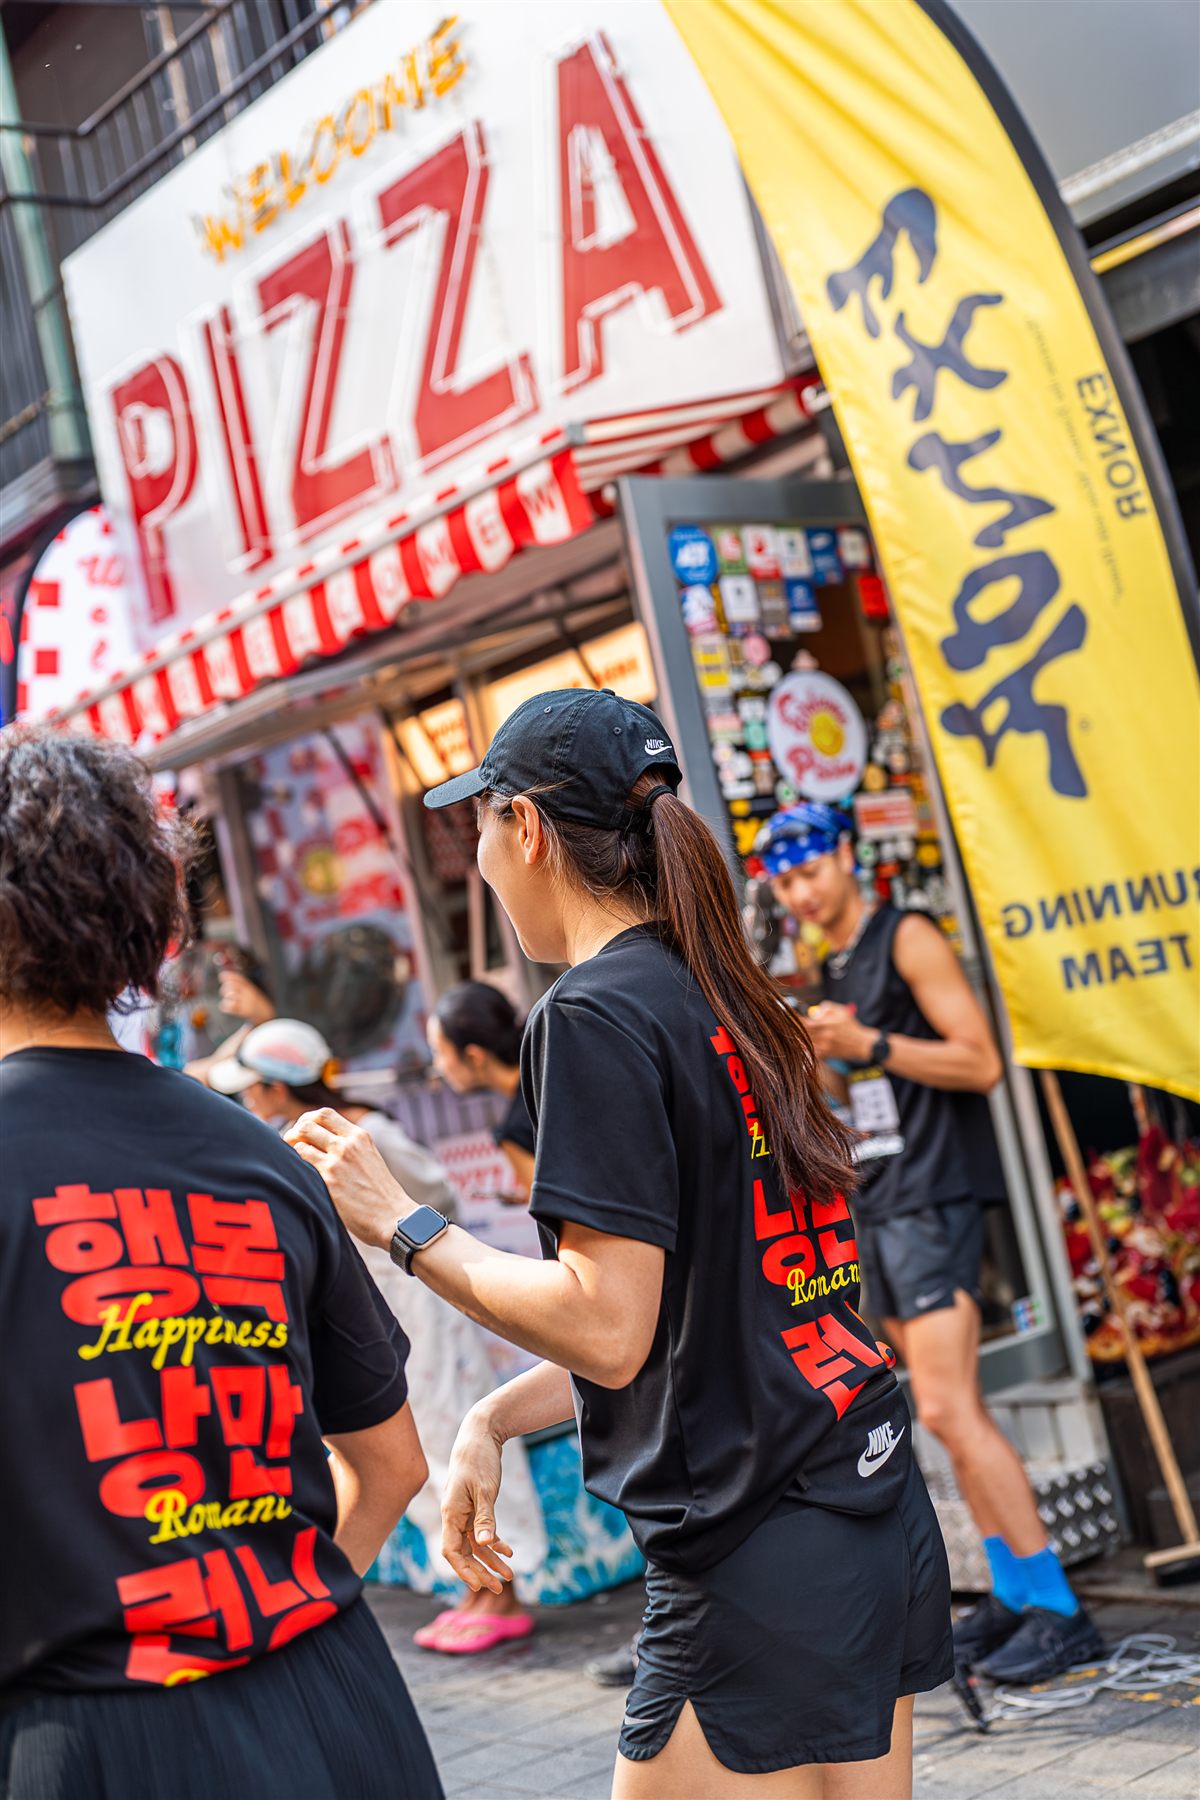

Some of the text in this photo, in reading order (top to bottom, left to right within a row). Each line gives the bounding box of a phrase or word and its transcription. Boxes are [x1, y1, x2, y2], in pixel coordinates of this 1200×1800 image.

[194, 14, 470, 265] WELCOME
[109, 30, 726, 625] PIZZA
[646, 738, 665, 749] NIKE
[33, 1183, 289, 1326] 행복
[786, 1262, 861, 1307] Roman
[77, 1292, 289, 1370] Happiness
[74, 1365, 304, 1518] 낭만
[865, 1420, 896, 1458] NIKE
